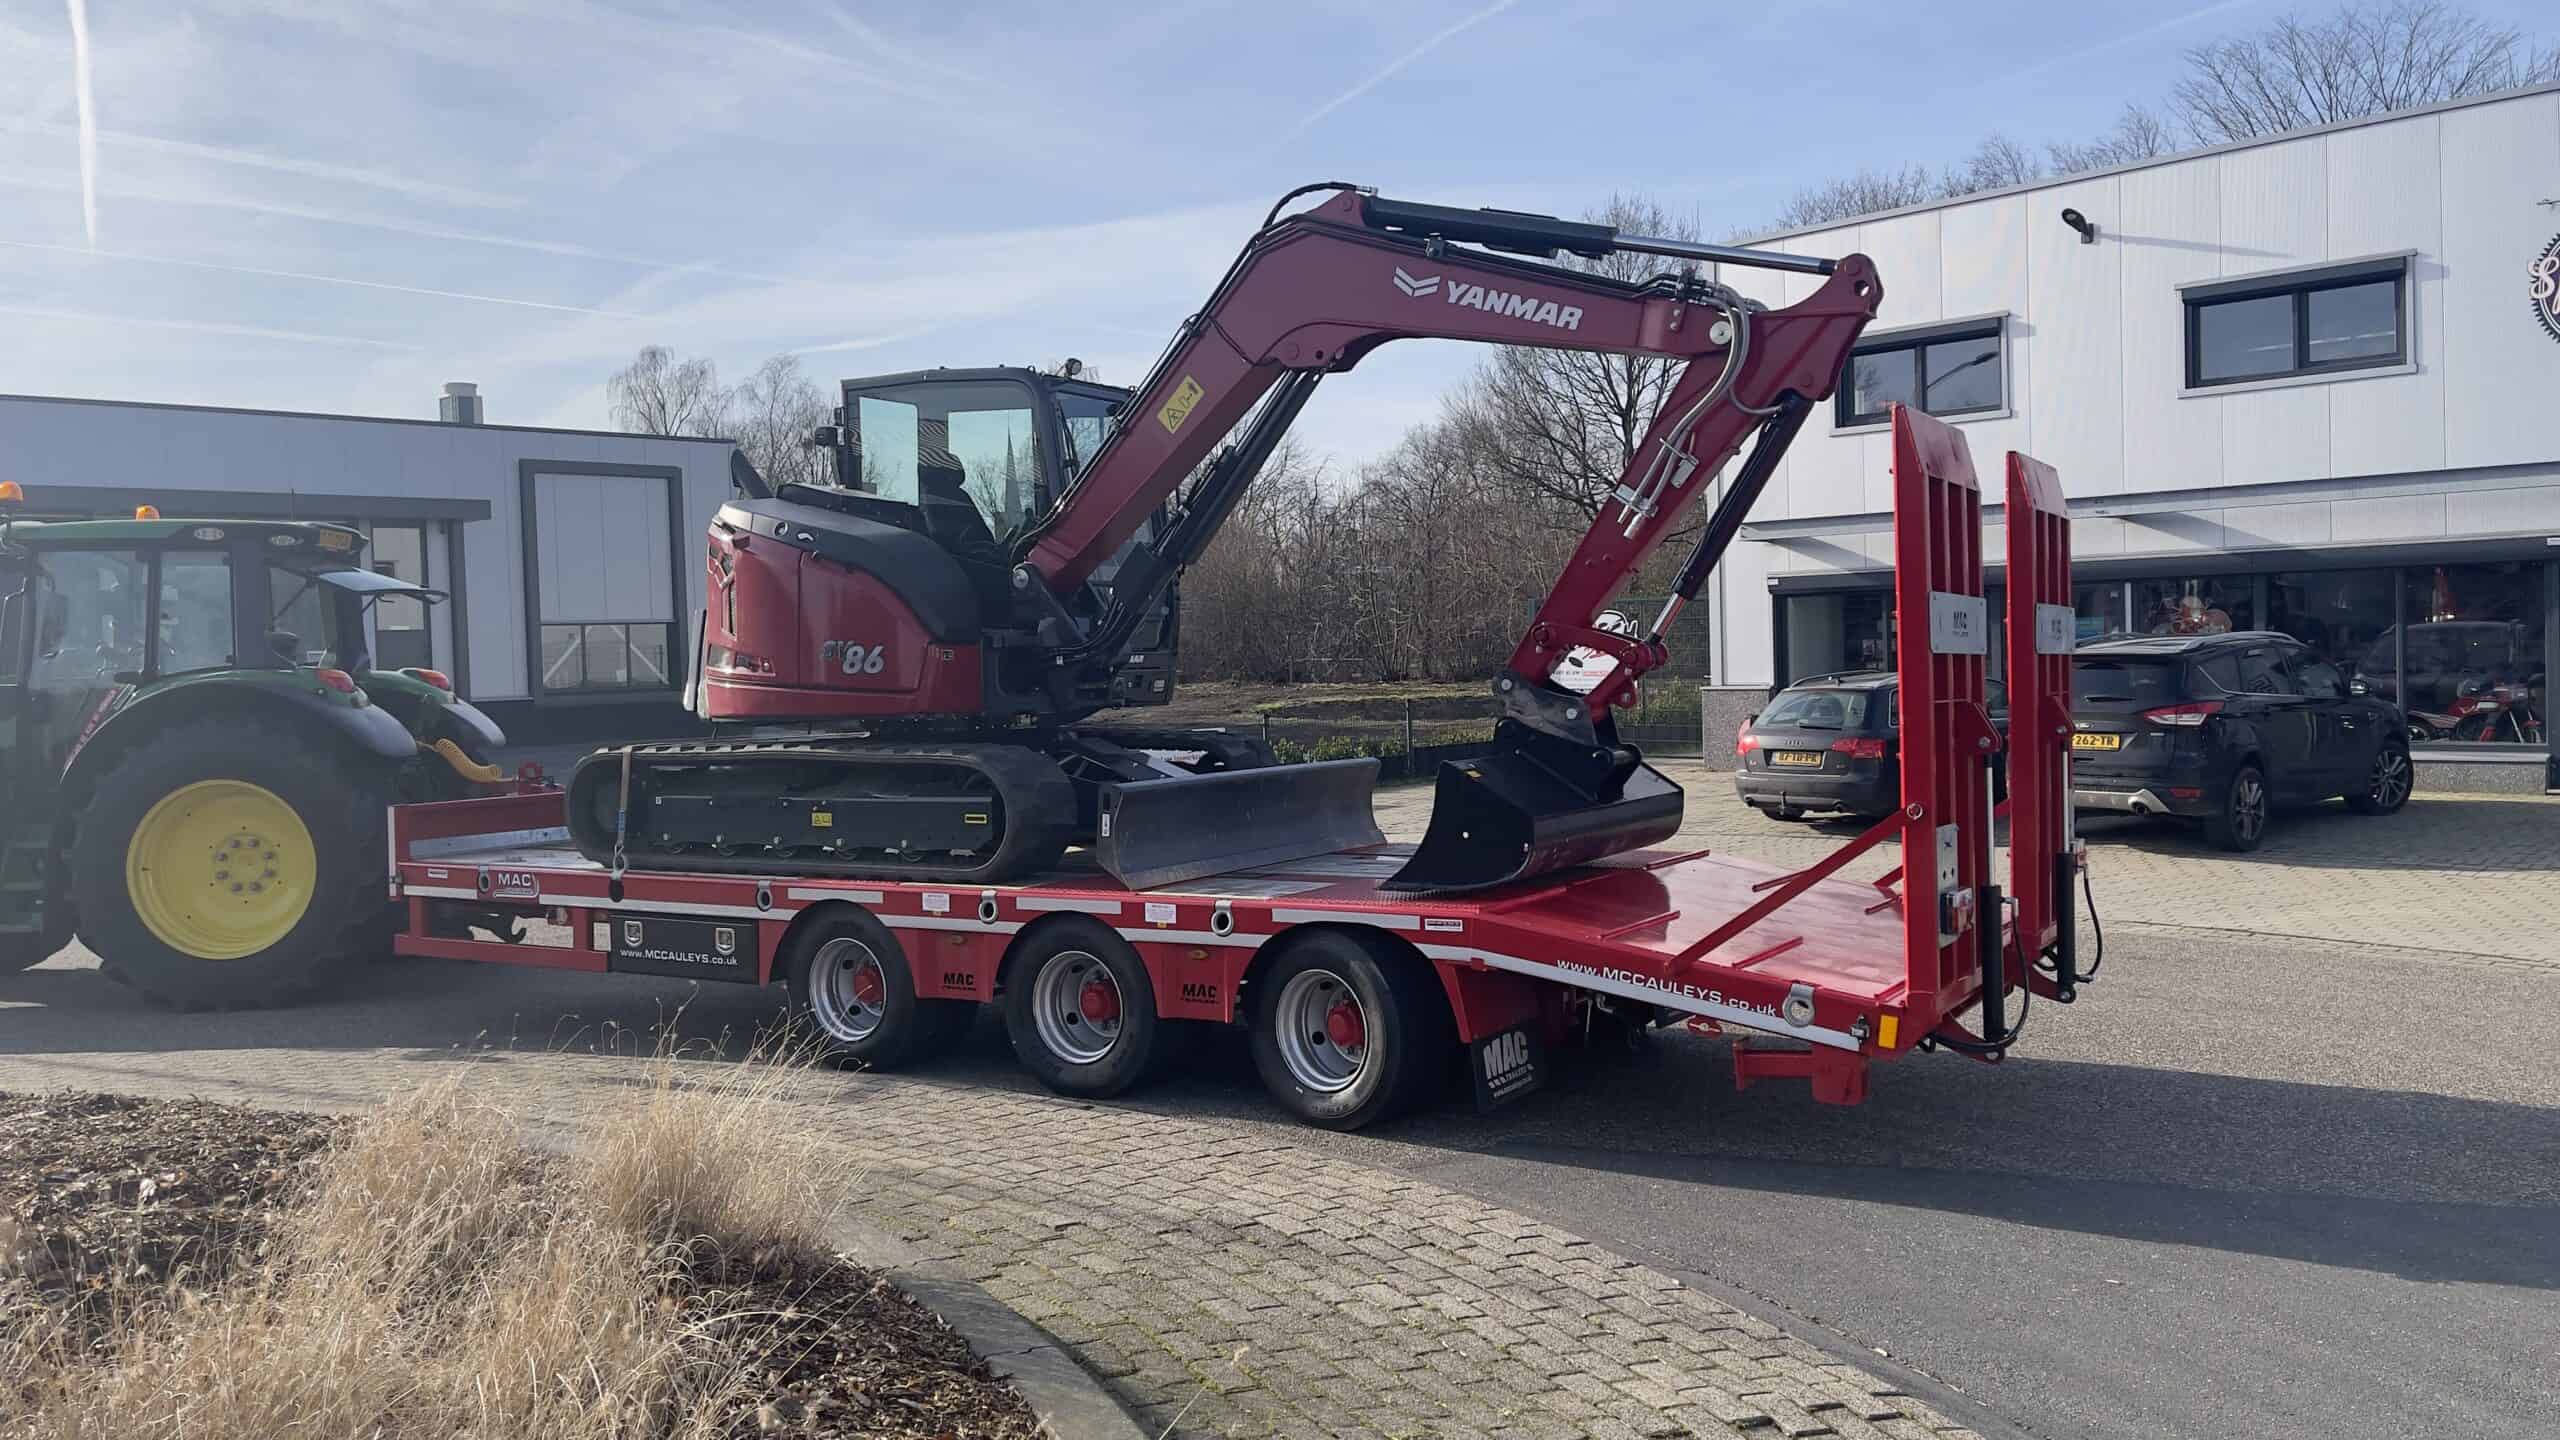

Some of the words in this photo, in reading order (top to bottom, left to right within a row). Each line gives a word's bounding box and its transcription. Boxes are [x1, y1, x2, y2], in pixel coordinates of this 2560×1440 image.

[1447, 280, 1584, 330] YANMAR
[842, 645, 884, 674] 86
[497, 872, 532, 887] MAC
[620, 948, 739, 966] www.MCCAULEYS.co.uk
[943, 972, 975, 986] MAC
[1556, 958, 1777, 1017] www.MCCAULEYS.co.uk
[1182, 984, 1217, 998] MAC
[1483, 1031, 1528, 1080] MAC
